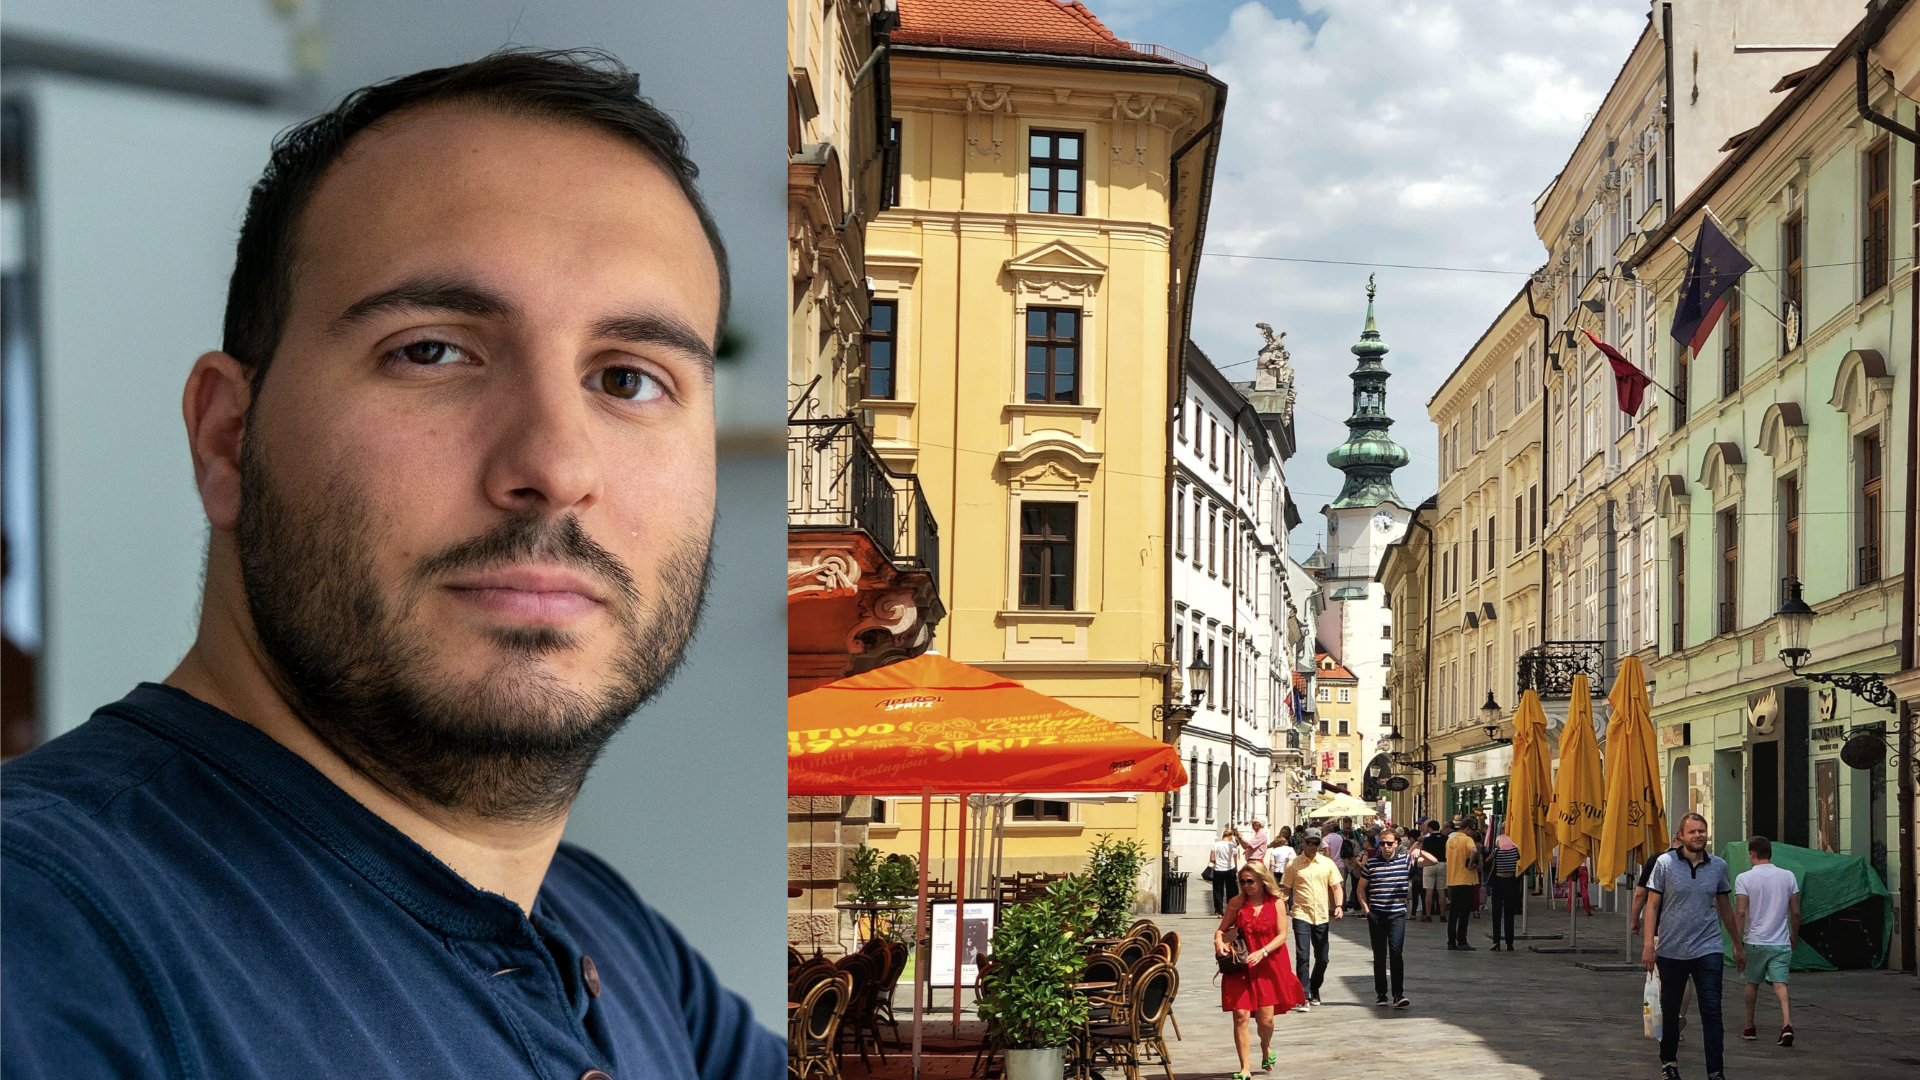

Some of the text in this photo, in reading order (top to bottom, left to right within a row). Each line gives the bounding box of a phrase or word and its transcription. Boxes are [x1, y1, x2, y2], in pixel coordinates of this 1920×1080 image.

[875, 695, 945, 708] APEROL
[884, 701, 934, 711] SPRITZ
[980, 712, 1053, 724] SPONTANEOUS
[1094, 729, 1135, 738] FONDATA
[1063, 736, 1106, 744] PADOVA
[934, 735, 1060, 763] SPRITZ
[810, 750, 854, 769] ITALIAN
[1108, 759, 1137, 770] APEROL
[852, 757, 929, 778] Contagious
